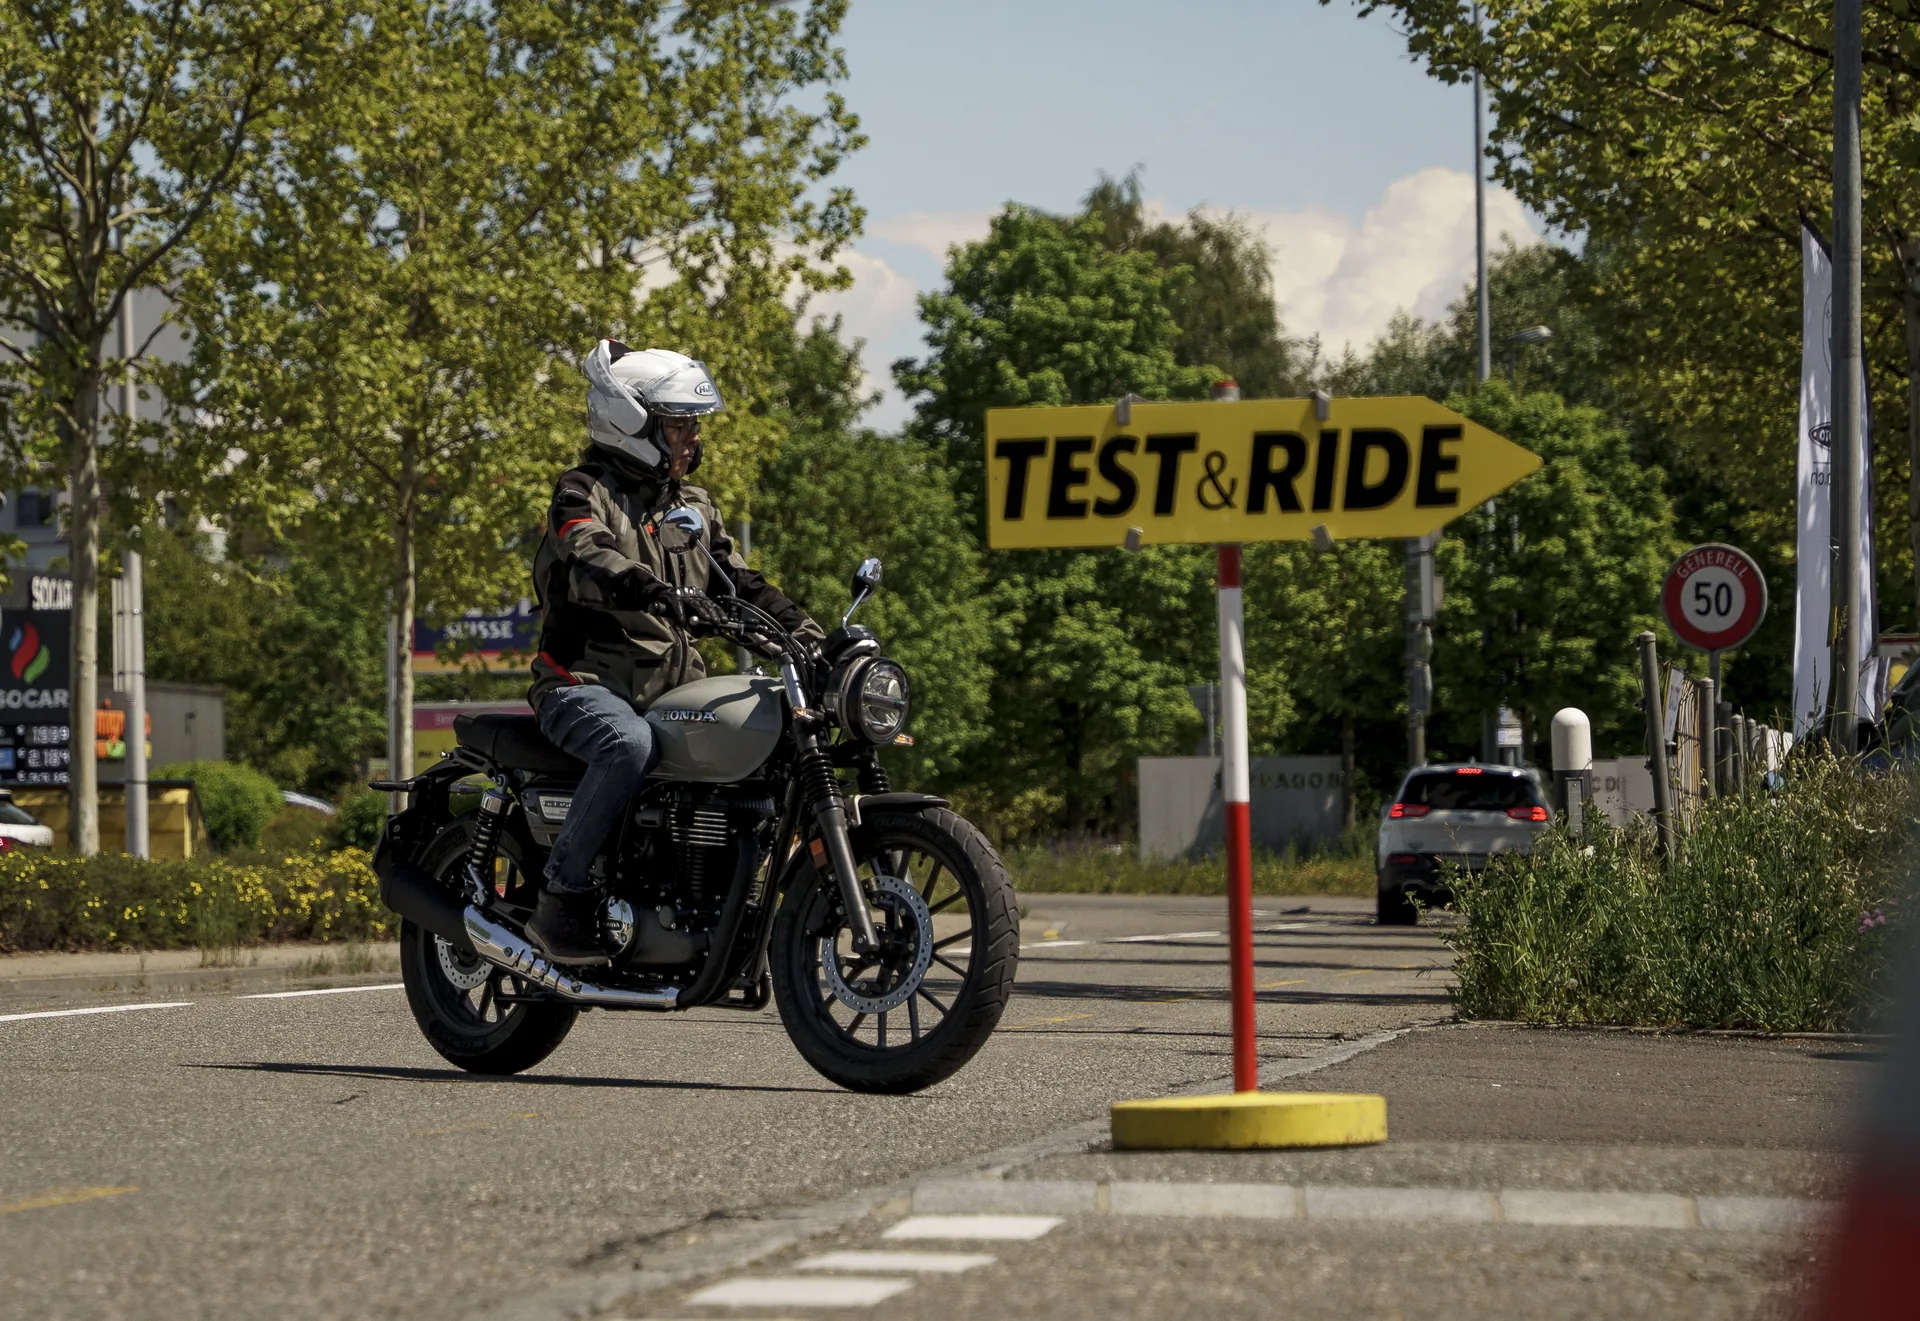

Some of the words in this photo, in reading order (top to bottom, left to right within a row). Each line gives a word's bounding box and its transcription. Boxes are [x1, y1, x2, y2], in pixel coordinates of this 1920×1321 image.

[994, 424, 1465, 521] TEST&RIDE
[1677, 550, 1749, 578] GENERELL
[1694, 581, 1732, 617] 50
[661, 710, 718, 722] HONDA
